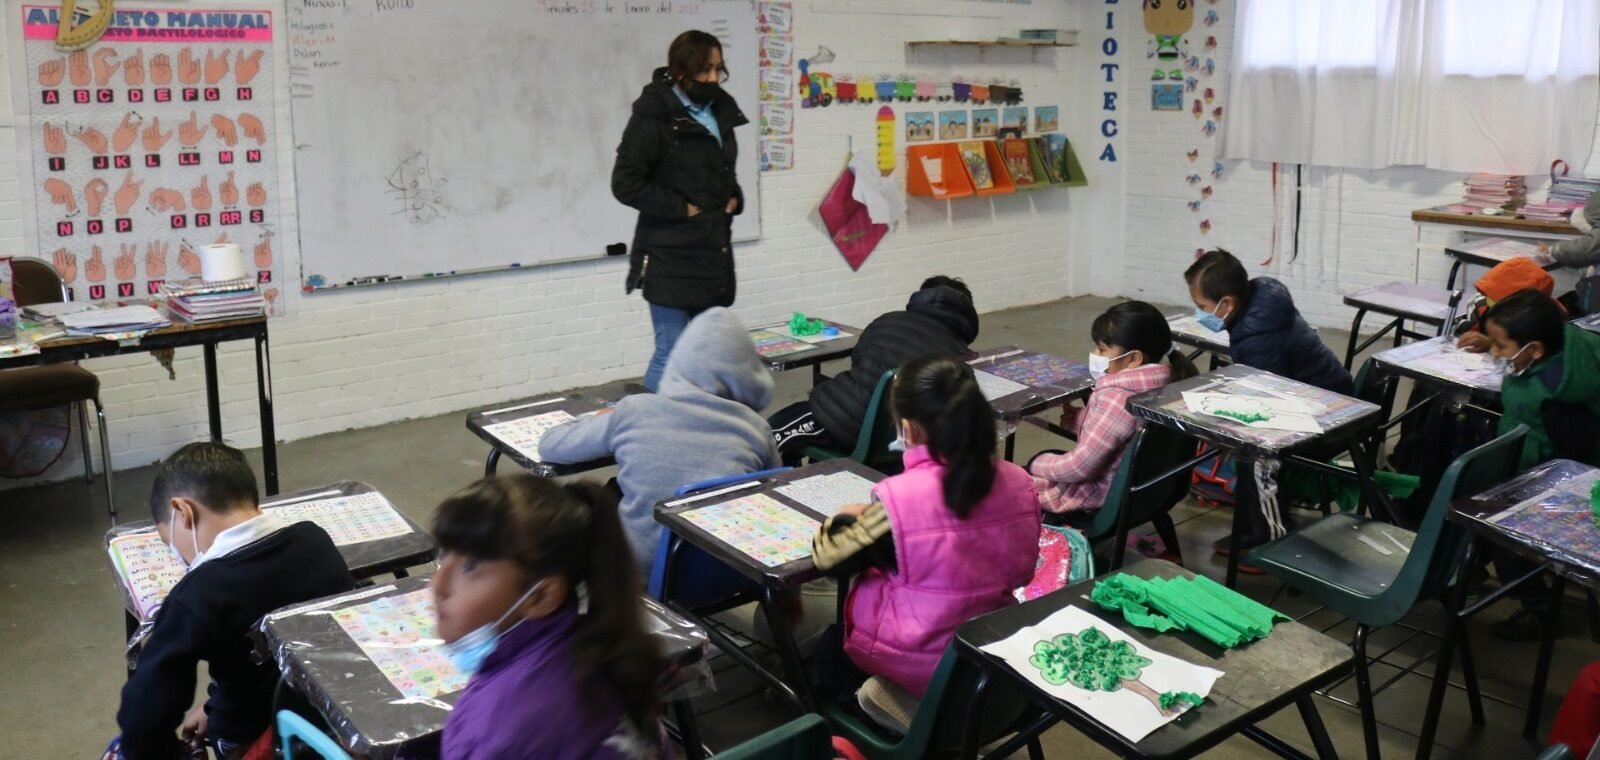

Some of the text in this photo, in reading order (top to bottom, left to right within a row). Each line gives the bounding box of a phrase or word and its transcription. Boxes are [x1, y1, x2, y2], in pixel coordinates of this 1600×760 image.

[167, 12, 268, 28] MANUAL
[1099, 0, 1119, 162] IOTECA
[46, 89, 250, 102] A B C D E F G H
[53, 151, 259, 170] I J K L LL M N
[89, 222, 100, 233] O
[119, 220, 129, 231] P
[172, 216, 183, 227] Q
[198, 214, 208, 225] R
[221, 212, 240, 224] RR
[252, 211, 261, 222] S
[92, 286, 103, 298] U
[121, 284, 132, 296] V
[260, 271, 269, 283] Z
